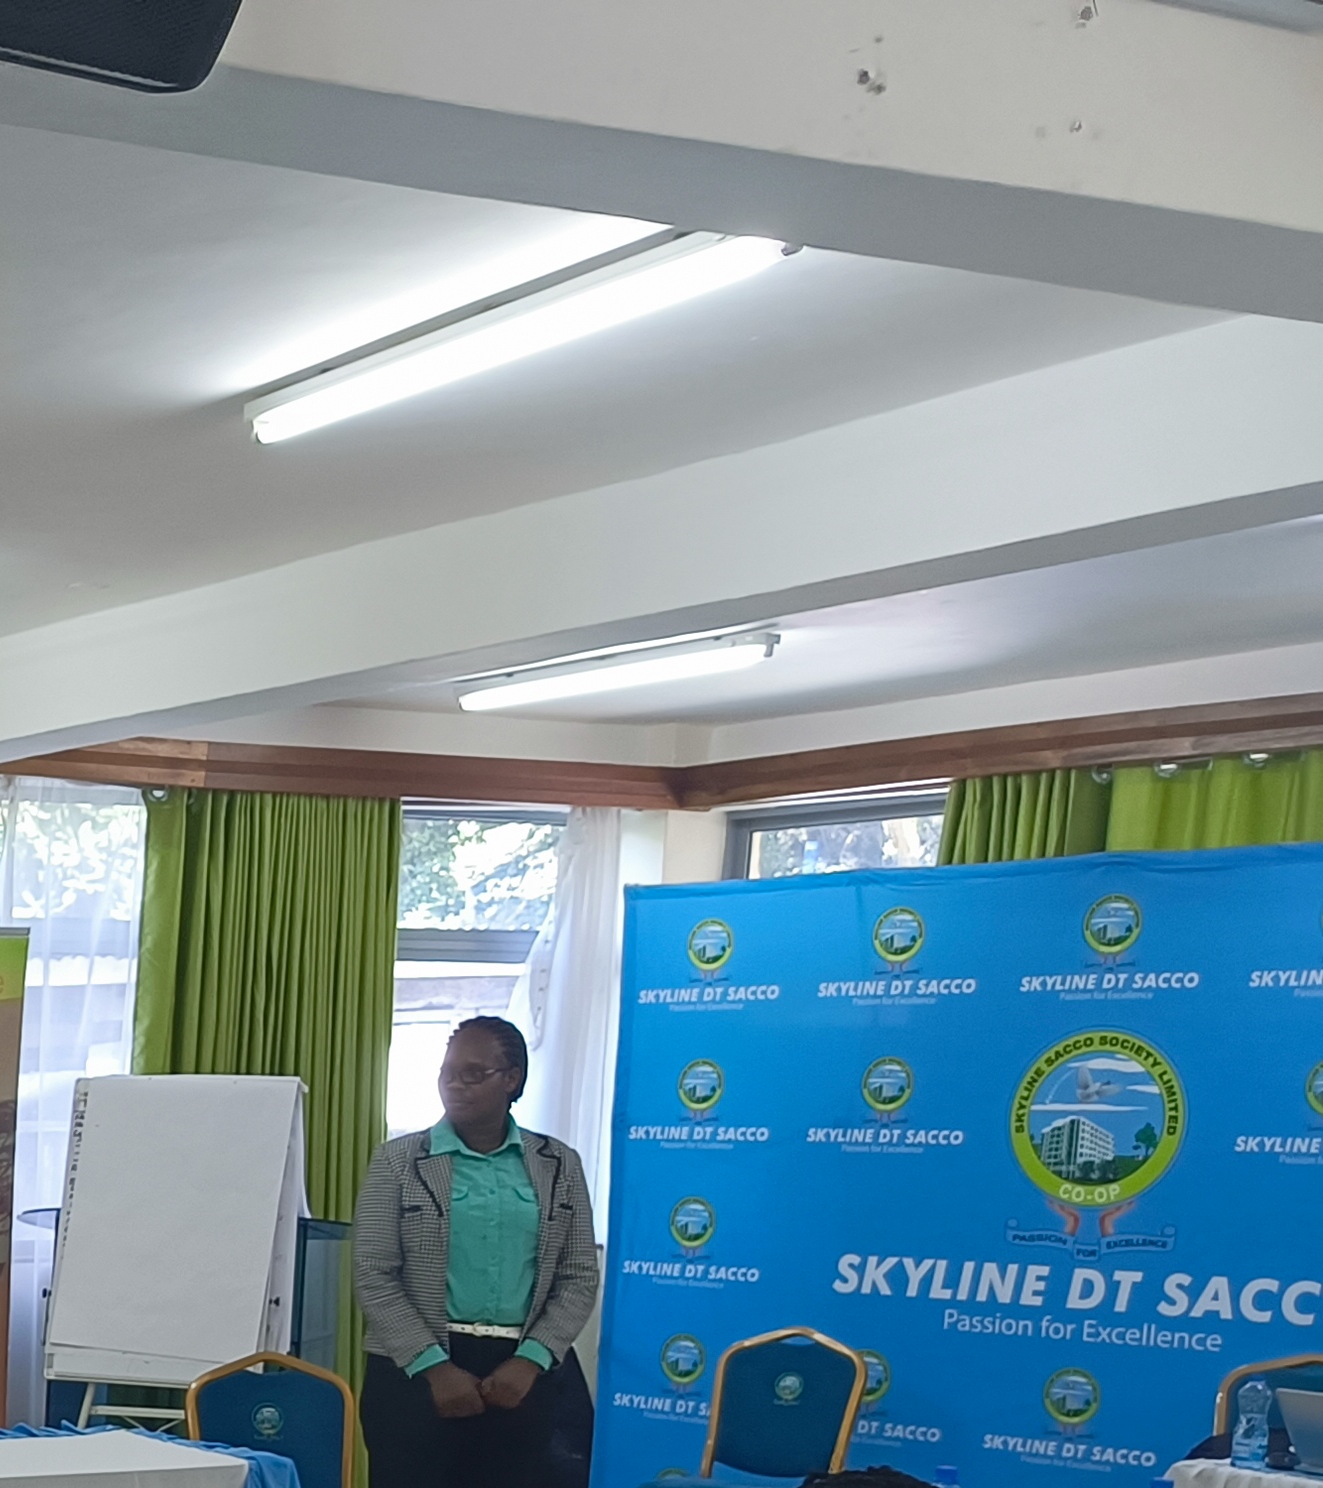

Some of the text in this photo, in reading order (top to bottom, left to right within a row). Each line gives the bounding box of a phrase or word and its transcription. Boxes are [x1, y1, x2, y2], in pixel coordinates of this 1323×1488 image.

[817, 978, 977, 998] SKYLINE DT SACCO
[1019, 971, 1200, 993] SKYLINE DT SACCO
[1249, 969, 1323, 988] SKYLIN
[638, 984, 780, 1004] SKYLINE DT SACCO
[1015, 1035, 1180, 1136] SKYLINE SACCO SOCIETY LIMITED
[628, 1125, 769, 1142] SKYLINE DT SACCO
[806, 1127, 964, 1146] SKYLINE DT SACCO
[1234, 1135, 1322, 1154] SKYLINE
[1059, 1183, 1120, 1203] CO-OP
[622, 1260, 681, 1277] SKYLINE
[684, 1264, 705, 1278] DT
[708, 1265, 760, 1283] SACCO
[832, 1253, 1322, 1327] SKYLINE DT SACC
[943, 1308, 1223, 1354] Passion for Excellence
[613, 1392, 672, 1412] SKYLINE
[675, 1400, 696, 1415] DT
[857, 1420, 880, 1434] DT
[882, 1422, 942, 1442] SACCO
[982, 1433, 1156, 1467] SKYLINE DT SACCO
